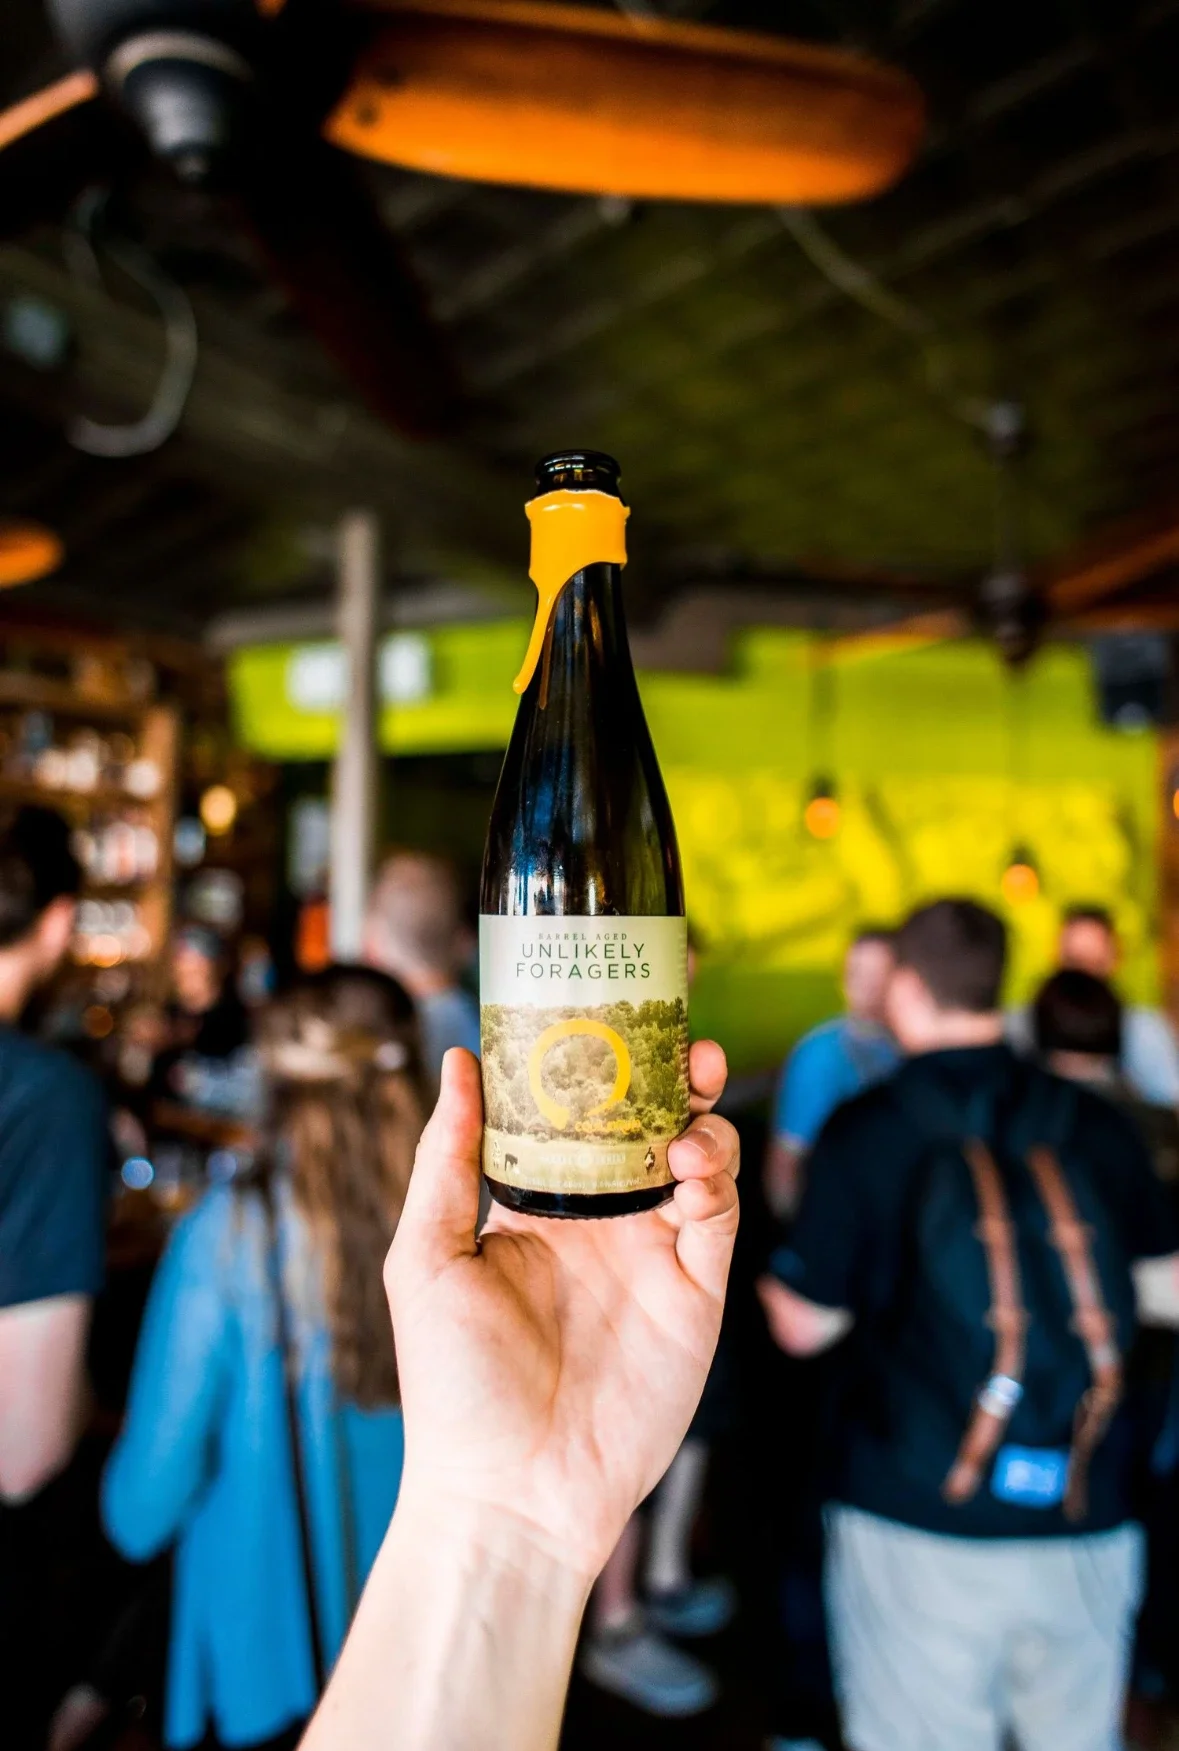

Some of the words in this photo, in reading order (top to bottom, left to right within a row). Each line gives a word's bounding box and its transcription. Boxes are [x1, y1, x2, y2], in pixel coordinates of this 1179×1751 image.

[538, 933, 586, 941] BARREL
[596, 933, 627, 941] AGED
[522, 943, 645, 959] UNLIKELY
[516, 962, 651, 979] FORAGERS
